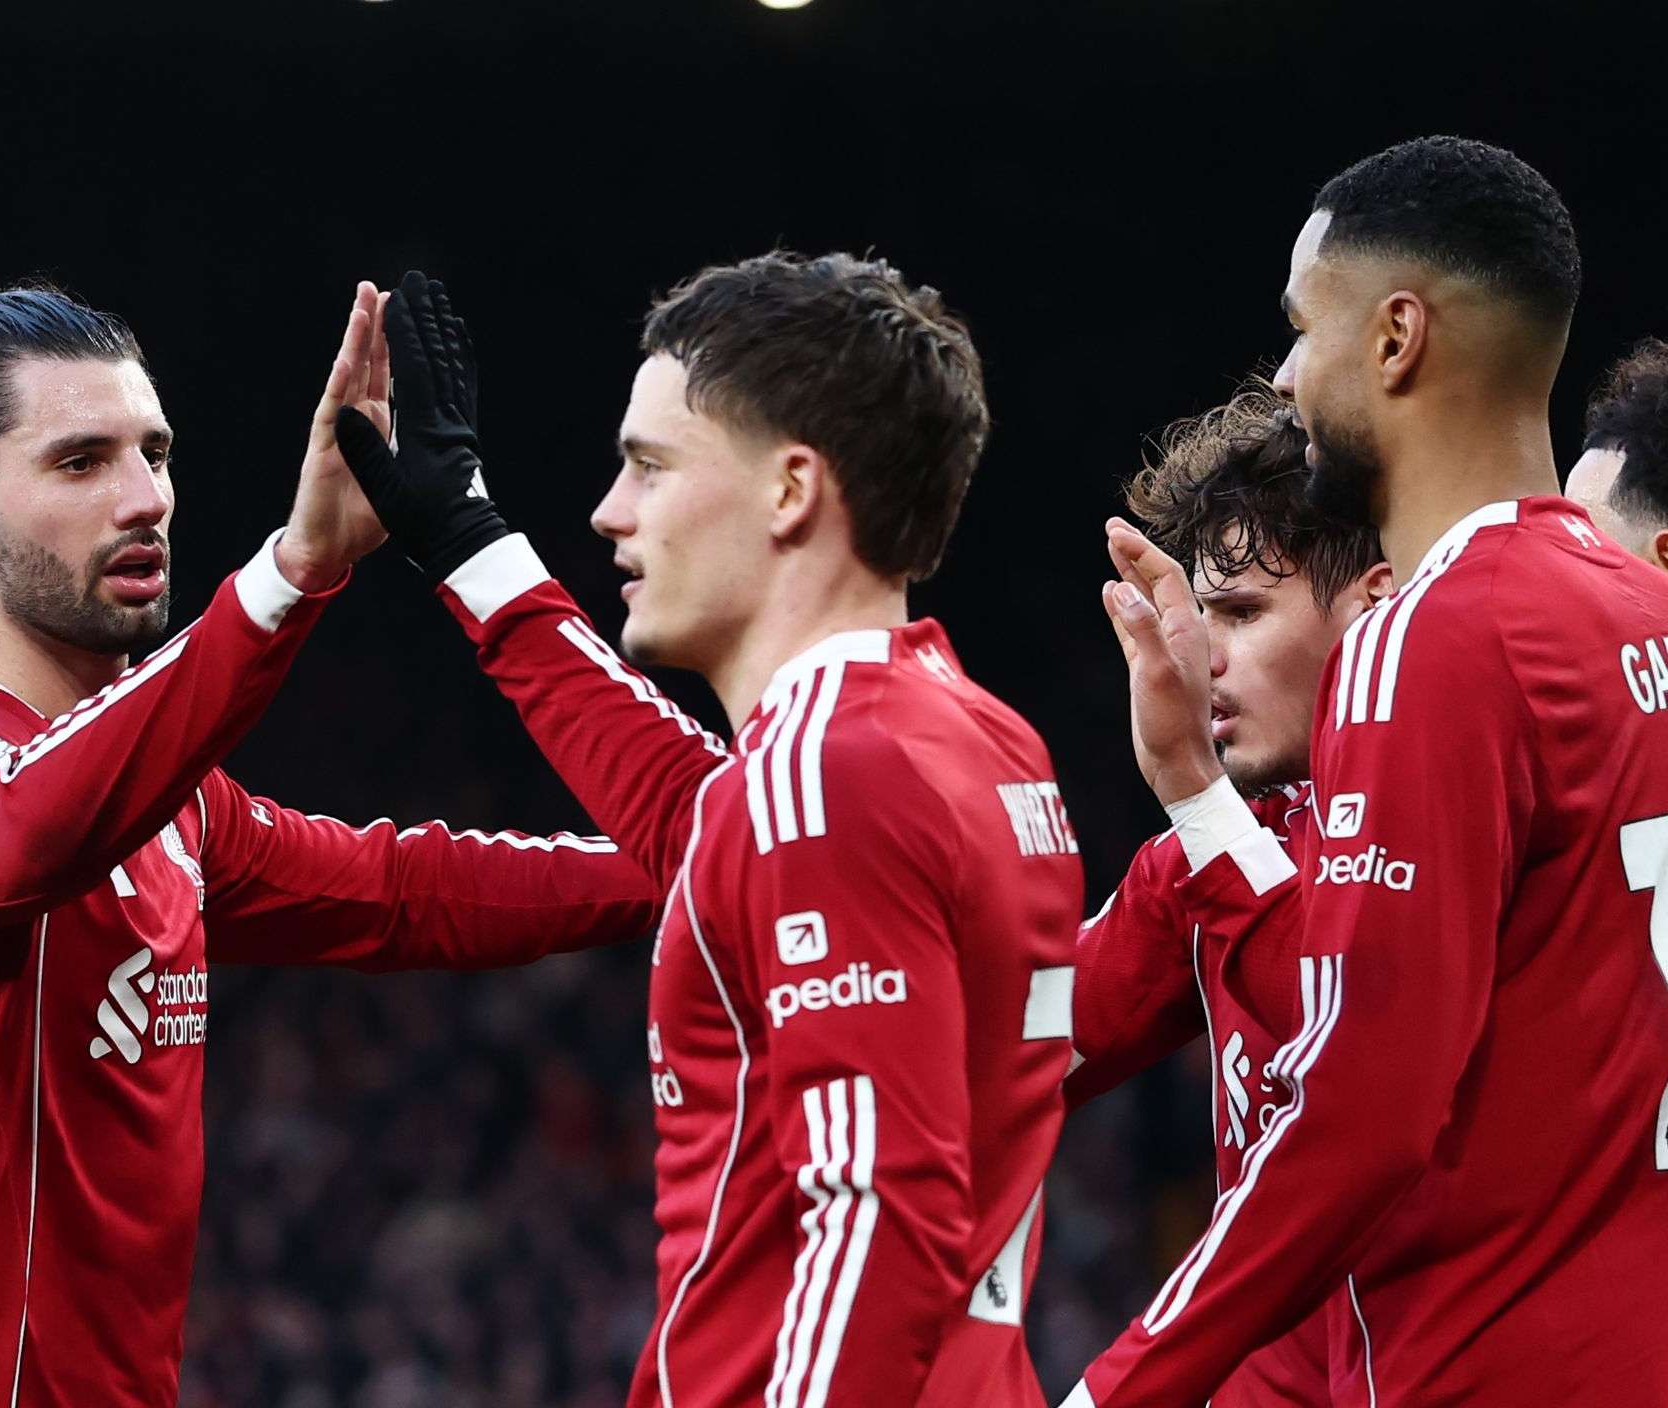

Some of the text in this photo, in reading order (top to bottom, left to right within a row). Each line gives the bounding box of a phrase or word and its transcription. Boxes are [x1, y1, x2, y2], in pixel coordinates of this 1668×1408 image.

[156, 965, 208, 1006] standa
[764, 961, 908, 1029] pedia
[154, 1006, 207, 1047] charter
